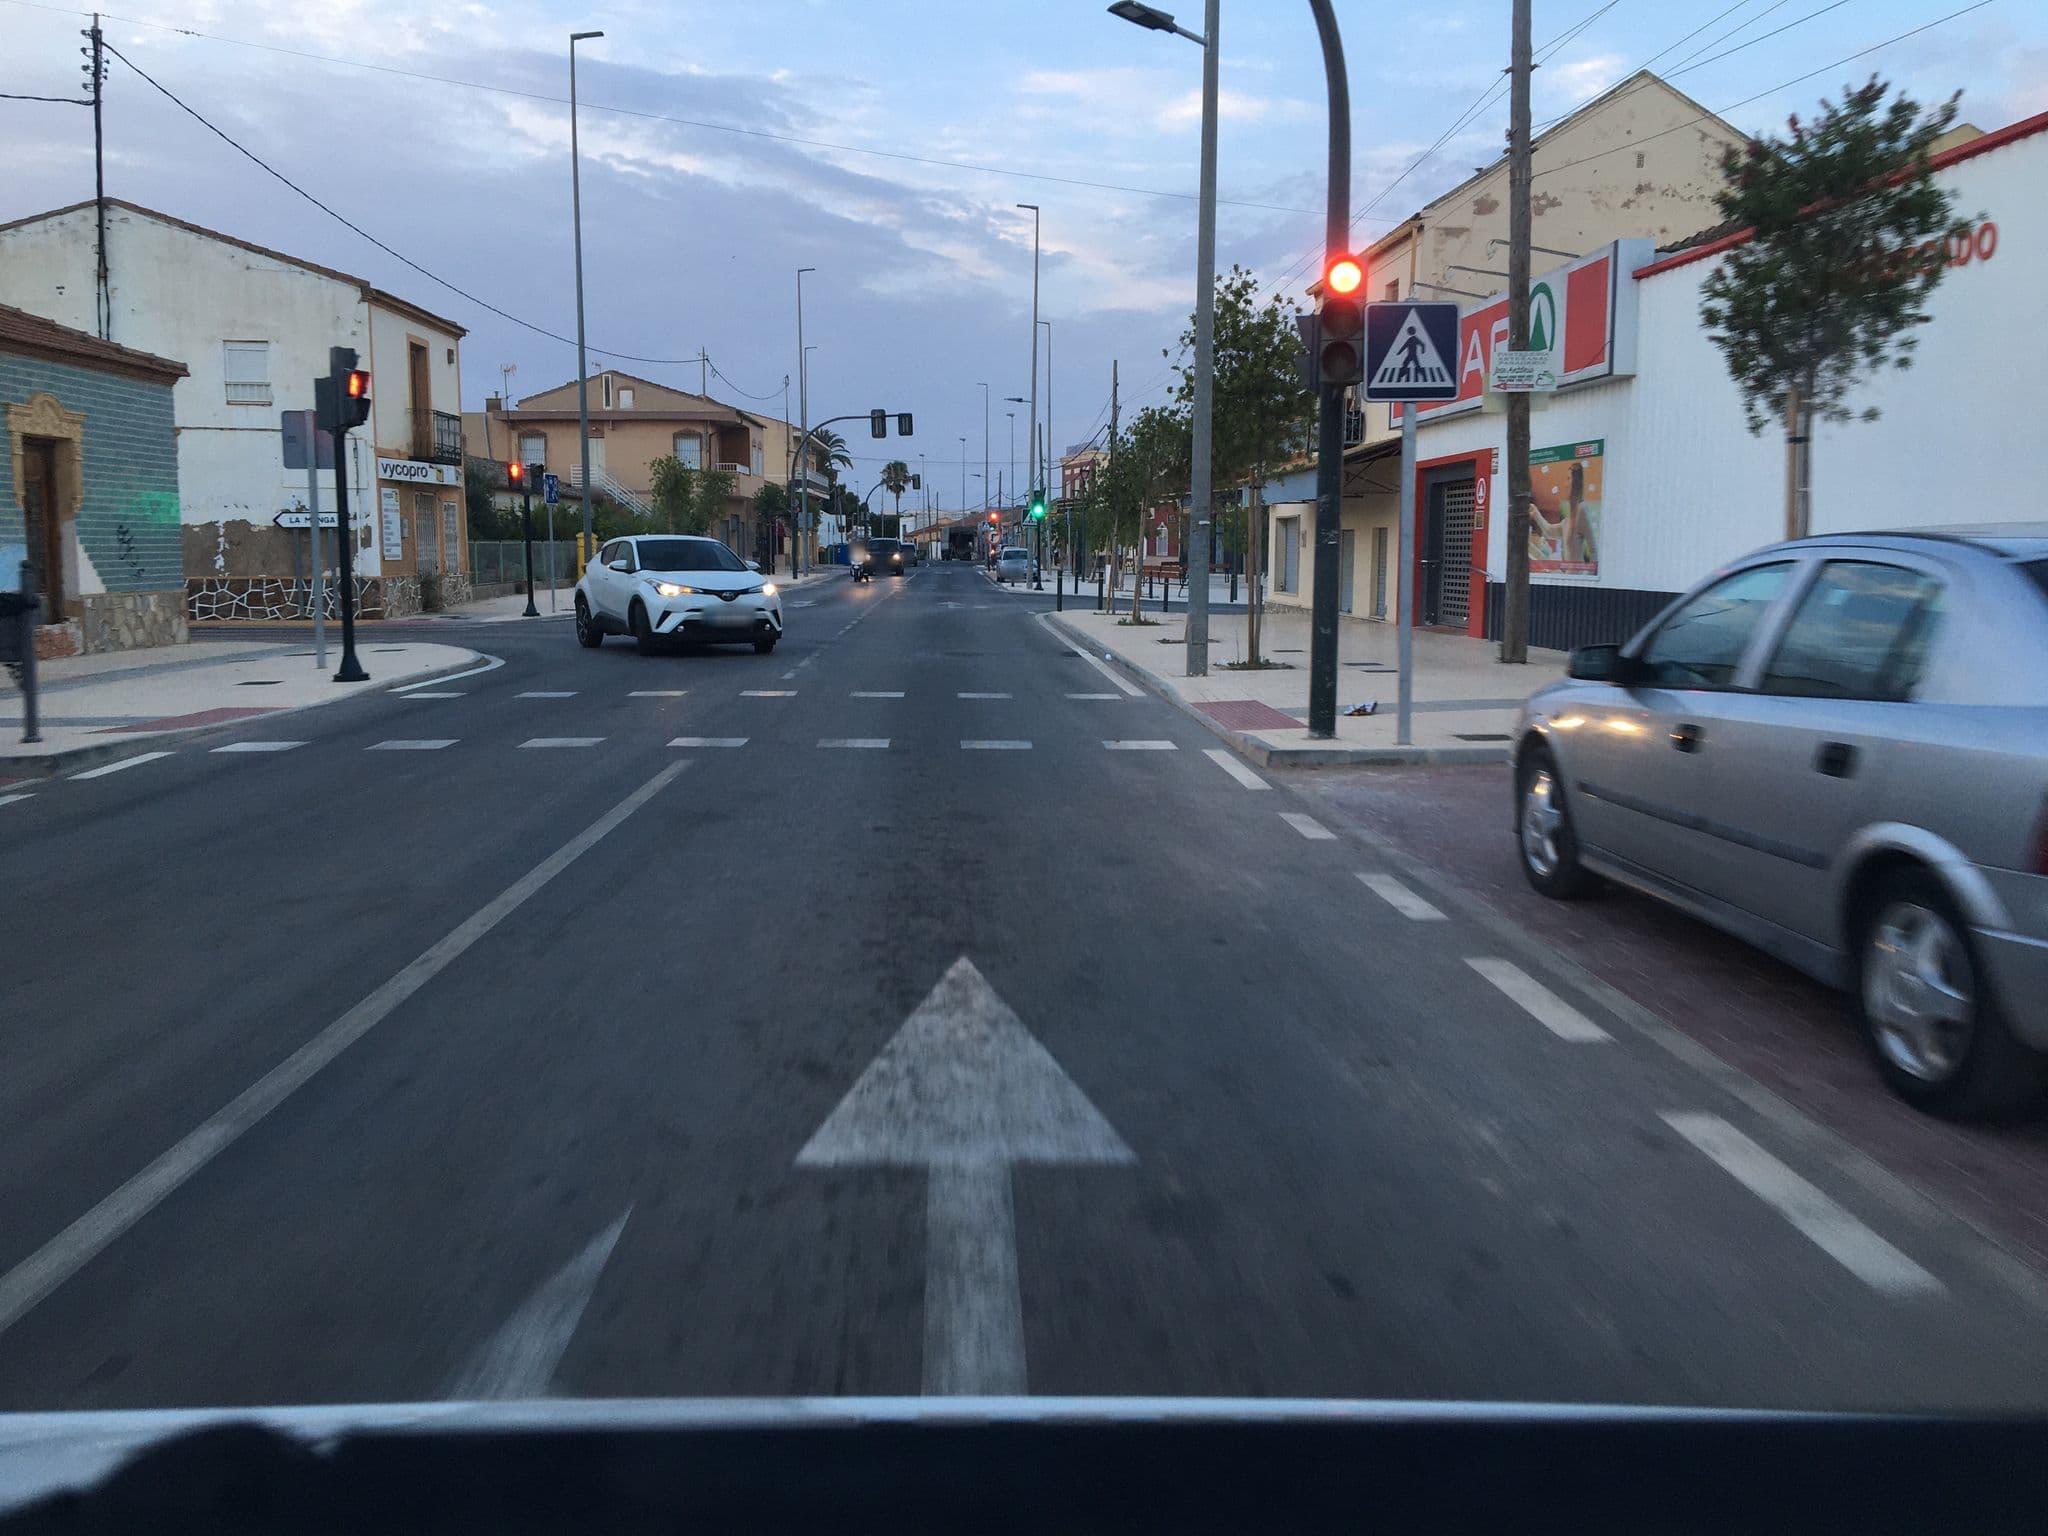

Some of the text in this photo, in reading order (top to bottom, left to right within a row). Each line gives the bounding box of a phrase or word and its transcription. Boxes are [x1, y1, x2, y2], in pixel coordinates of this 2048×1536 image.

[380, 462, 429, 480] vycopro
[289, 516, 336, 524] LA MNGA
